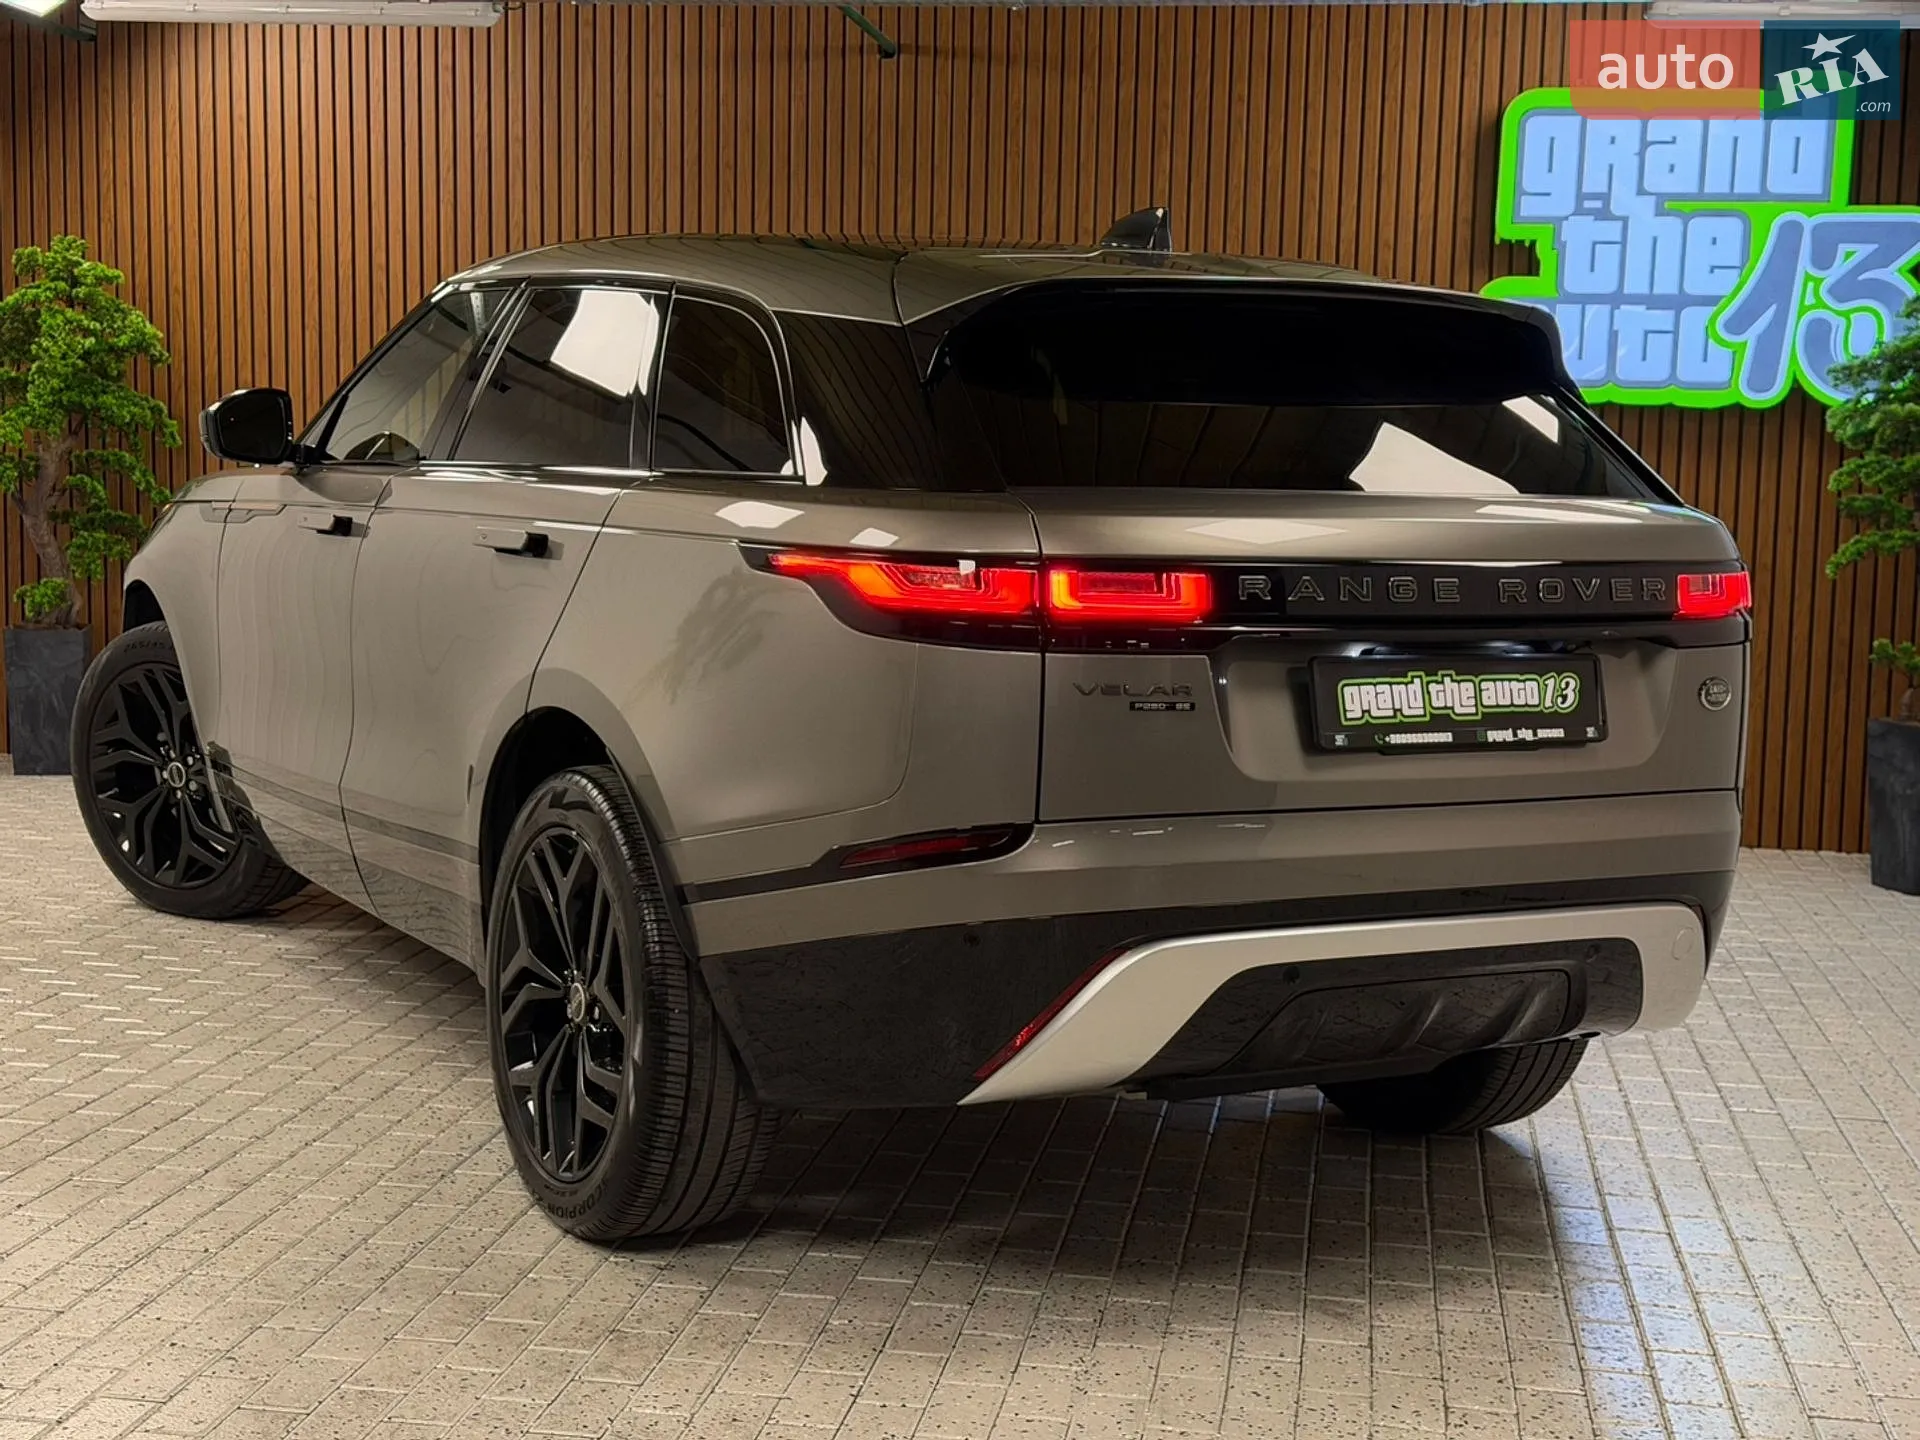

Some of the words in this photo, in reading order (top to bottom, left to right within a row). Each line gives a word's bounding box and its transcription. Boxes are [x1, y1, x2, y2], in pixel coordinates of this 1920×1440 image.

[1560, 197, 1746, 296] the
[1556, 303, 1734, 385] uto
[1238, 575, 1460, 602] RANGE
[1498, 578, 1667, 603] ROVER
[1072, 681, 1192, 697] VELAR
[1343, 677, 1424, 719] grand
[1428, 676, 1476, 714] the
[1480, 680, 1540, 707] auto
